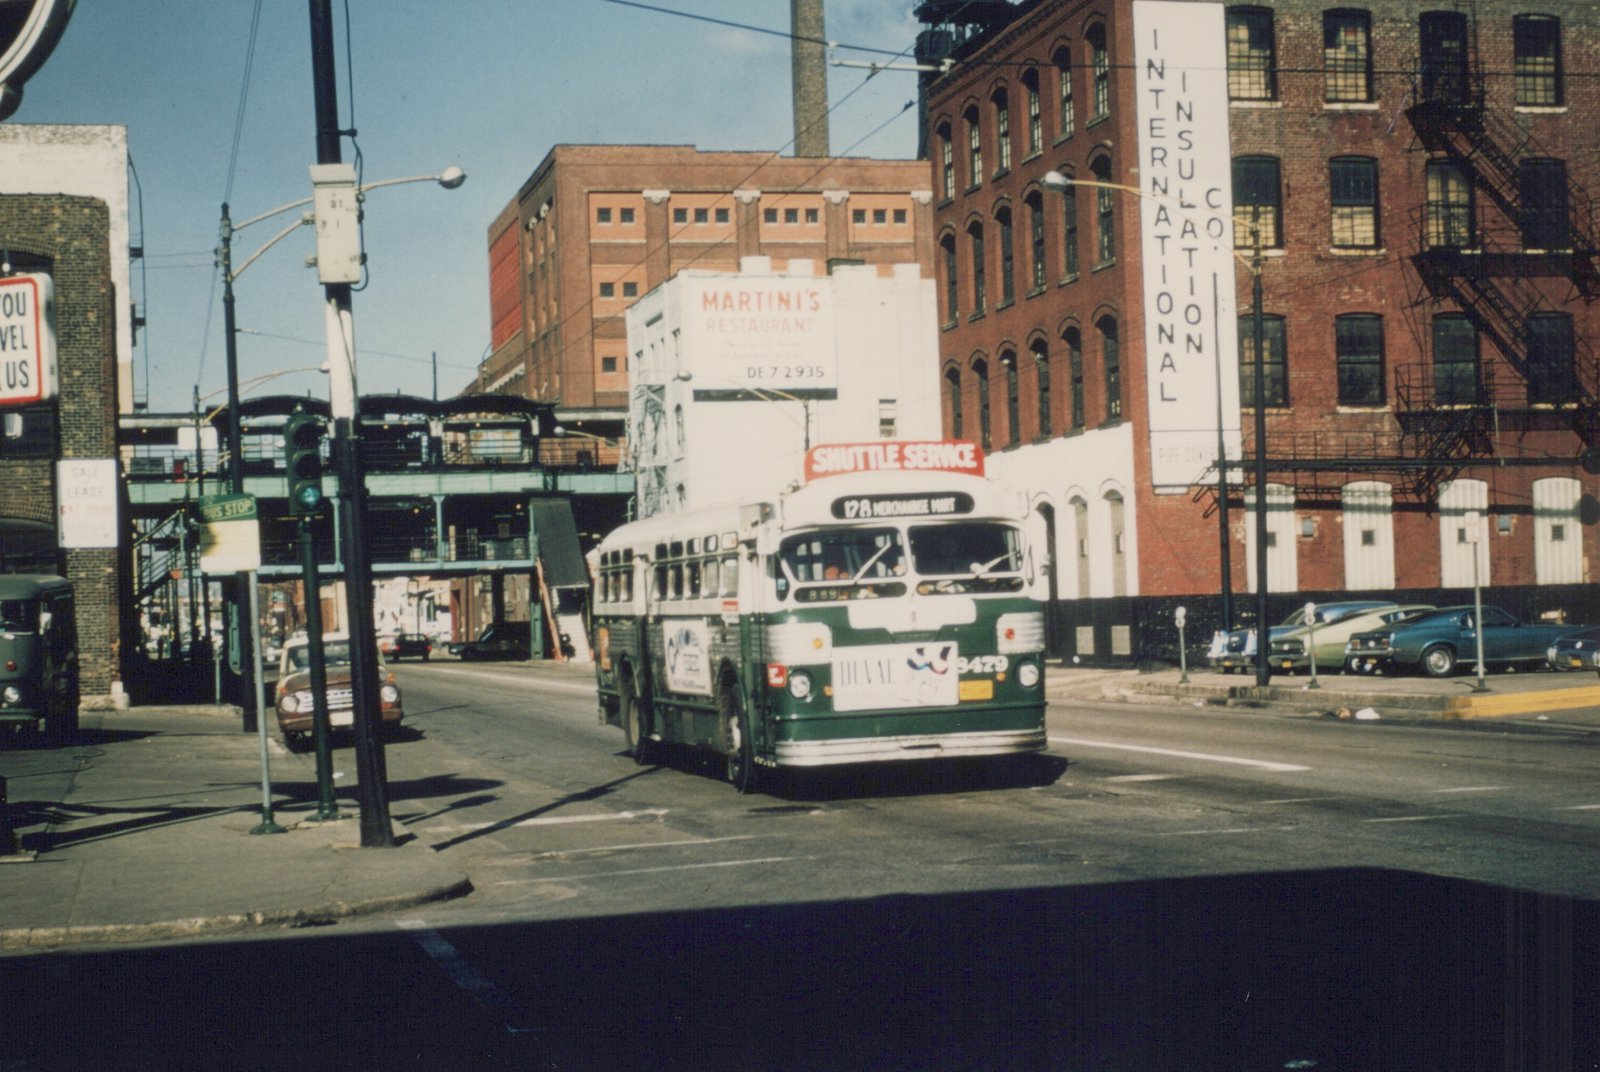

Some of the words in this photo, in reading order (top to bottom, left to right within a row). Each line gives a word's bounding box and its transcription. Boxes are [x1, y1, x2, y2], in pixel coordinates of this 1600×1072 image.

[1147, 28, 1177, 402] INTERNATIONAL
[1176, 71, 1203, 354] INSULATION
[0, 291, 26, 318] OU
[702, 288, 821, 312] MARTINI'S
[706, 318, 815, 333] RESTAURANT
[811, 444, 900, 473] SHUTTLE
[903, 443, 978, 469] SERVICE
[67, 486, 104, 498] LEASE
[224, 499, 252, 517] STOP
[844, 499, 872, 519] 128
[957, 654, 1009, 674] 3479
